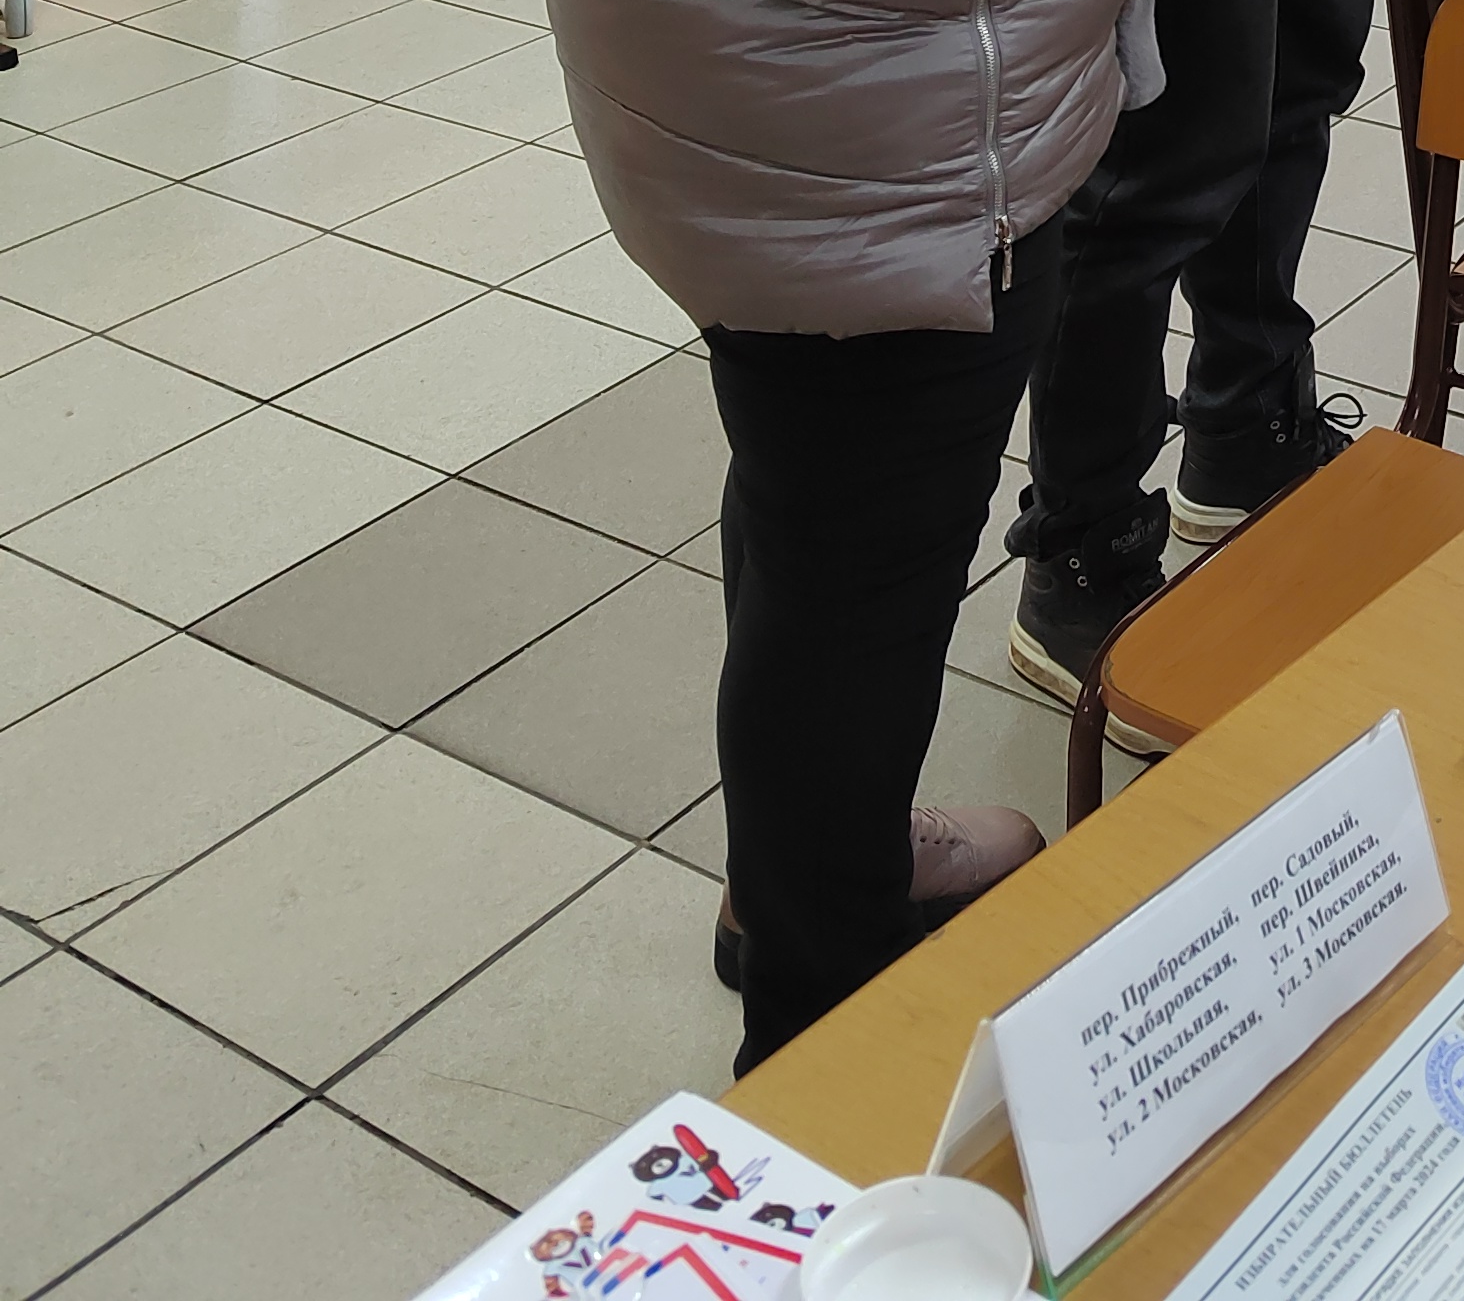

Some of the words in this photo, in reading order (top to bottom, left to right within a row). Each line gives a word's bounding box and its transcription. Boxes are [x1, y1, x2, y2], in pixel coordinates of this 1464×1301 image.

[1250, 878, 1284, 908] пер.
[1285, 810, 1359, 878] Садовый,
[1260, 907, 1294, 939] пер.
[1294, 832, 1380, 907] Швейника,
[1268, 945, 1295, 975] ул.
[1296, 925, 1306, 947] 1
[1307, 850, 1402, 932] Московская,
[1080, 1013, 1119, 1046] пер.
[1120, 907, 1240, 1013] Прибрежный,
[1276, 977, 1302, 1008] ул.
[1304, 957, 1314, 979] 3
[1315, 883, 1408, 966] Московская.
[1088, 1054, 1118, 1087] ул.
[1119, 950, 1238, 1054] Хабаровская,
[1097, 1089, 1128, 1121] ул.
[1129, 999, 1230, 1088] Школьная,
[1106, 1123, 1136, 1156] ул.
[1139, 1099, 1151, 1121] 2
[1153, 1009, 1263, 1110] Московская,
[1235, 1167, 1343, 1291] ИЗБИРАТЕЛЬНЫЙ
[1339, 1087, 1413, 1172] БЮЛЛЕТЕНЬ
[1298, 1191, 1361, 1265] голосования
[1360, 1175, 1375, 1192] на
[1374, 1124, 1416, 1176] выборах
[1332, 1183, 1394, 1251] Российской
[1372, 1219, 1388, 1236] 17
[1386, 1187, 1418, 1221] марта
[1413, 1157, 1439, 1187] 2024
